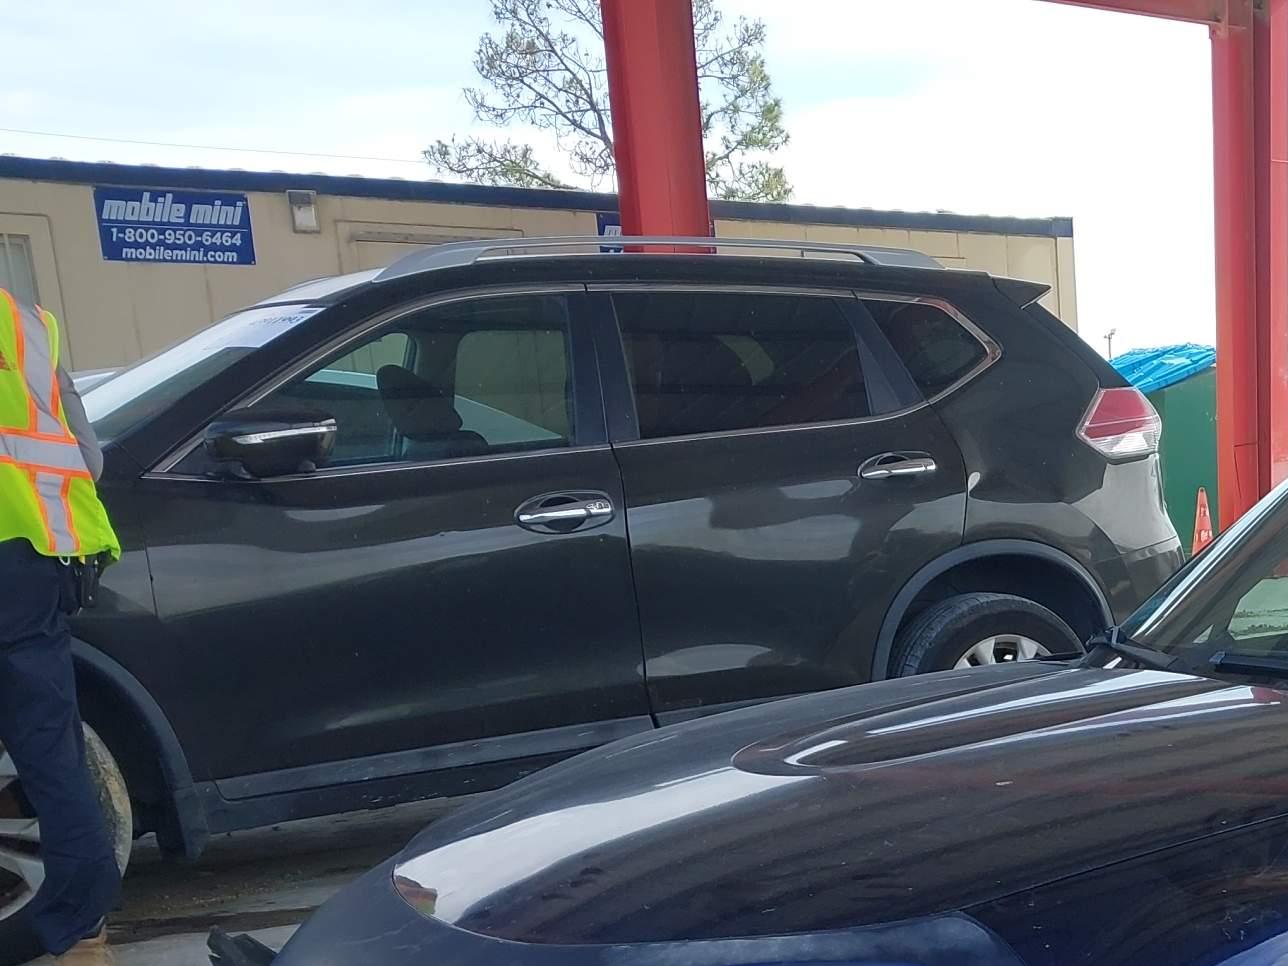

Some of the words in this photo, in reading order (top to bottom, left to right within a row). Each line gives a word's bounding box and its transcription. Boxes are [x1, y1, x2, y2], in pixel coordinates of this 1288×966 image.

[102, 192, 185, 223] mobile
[190, 200, 243, 225] mini
[111, 228, 242, 246] 1-800-950-6464
[122, 246, 237, 262] mobilemini.com
